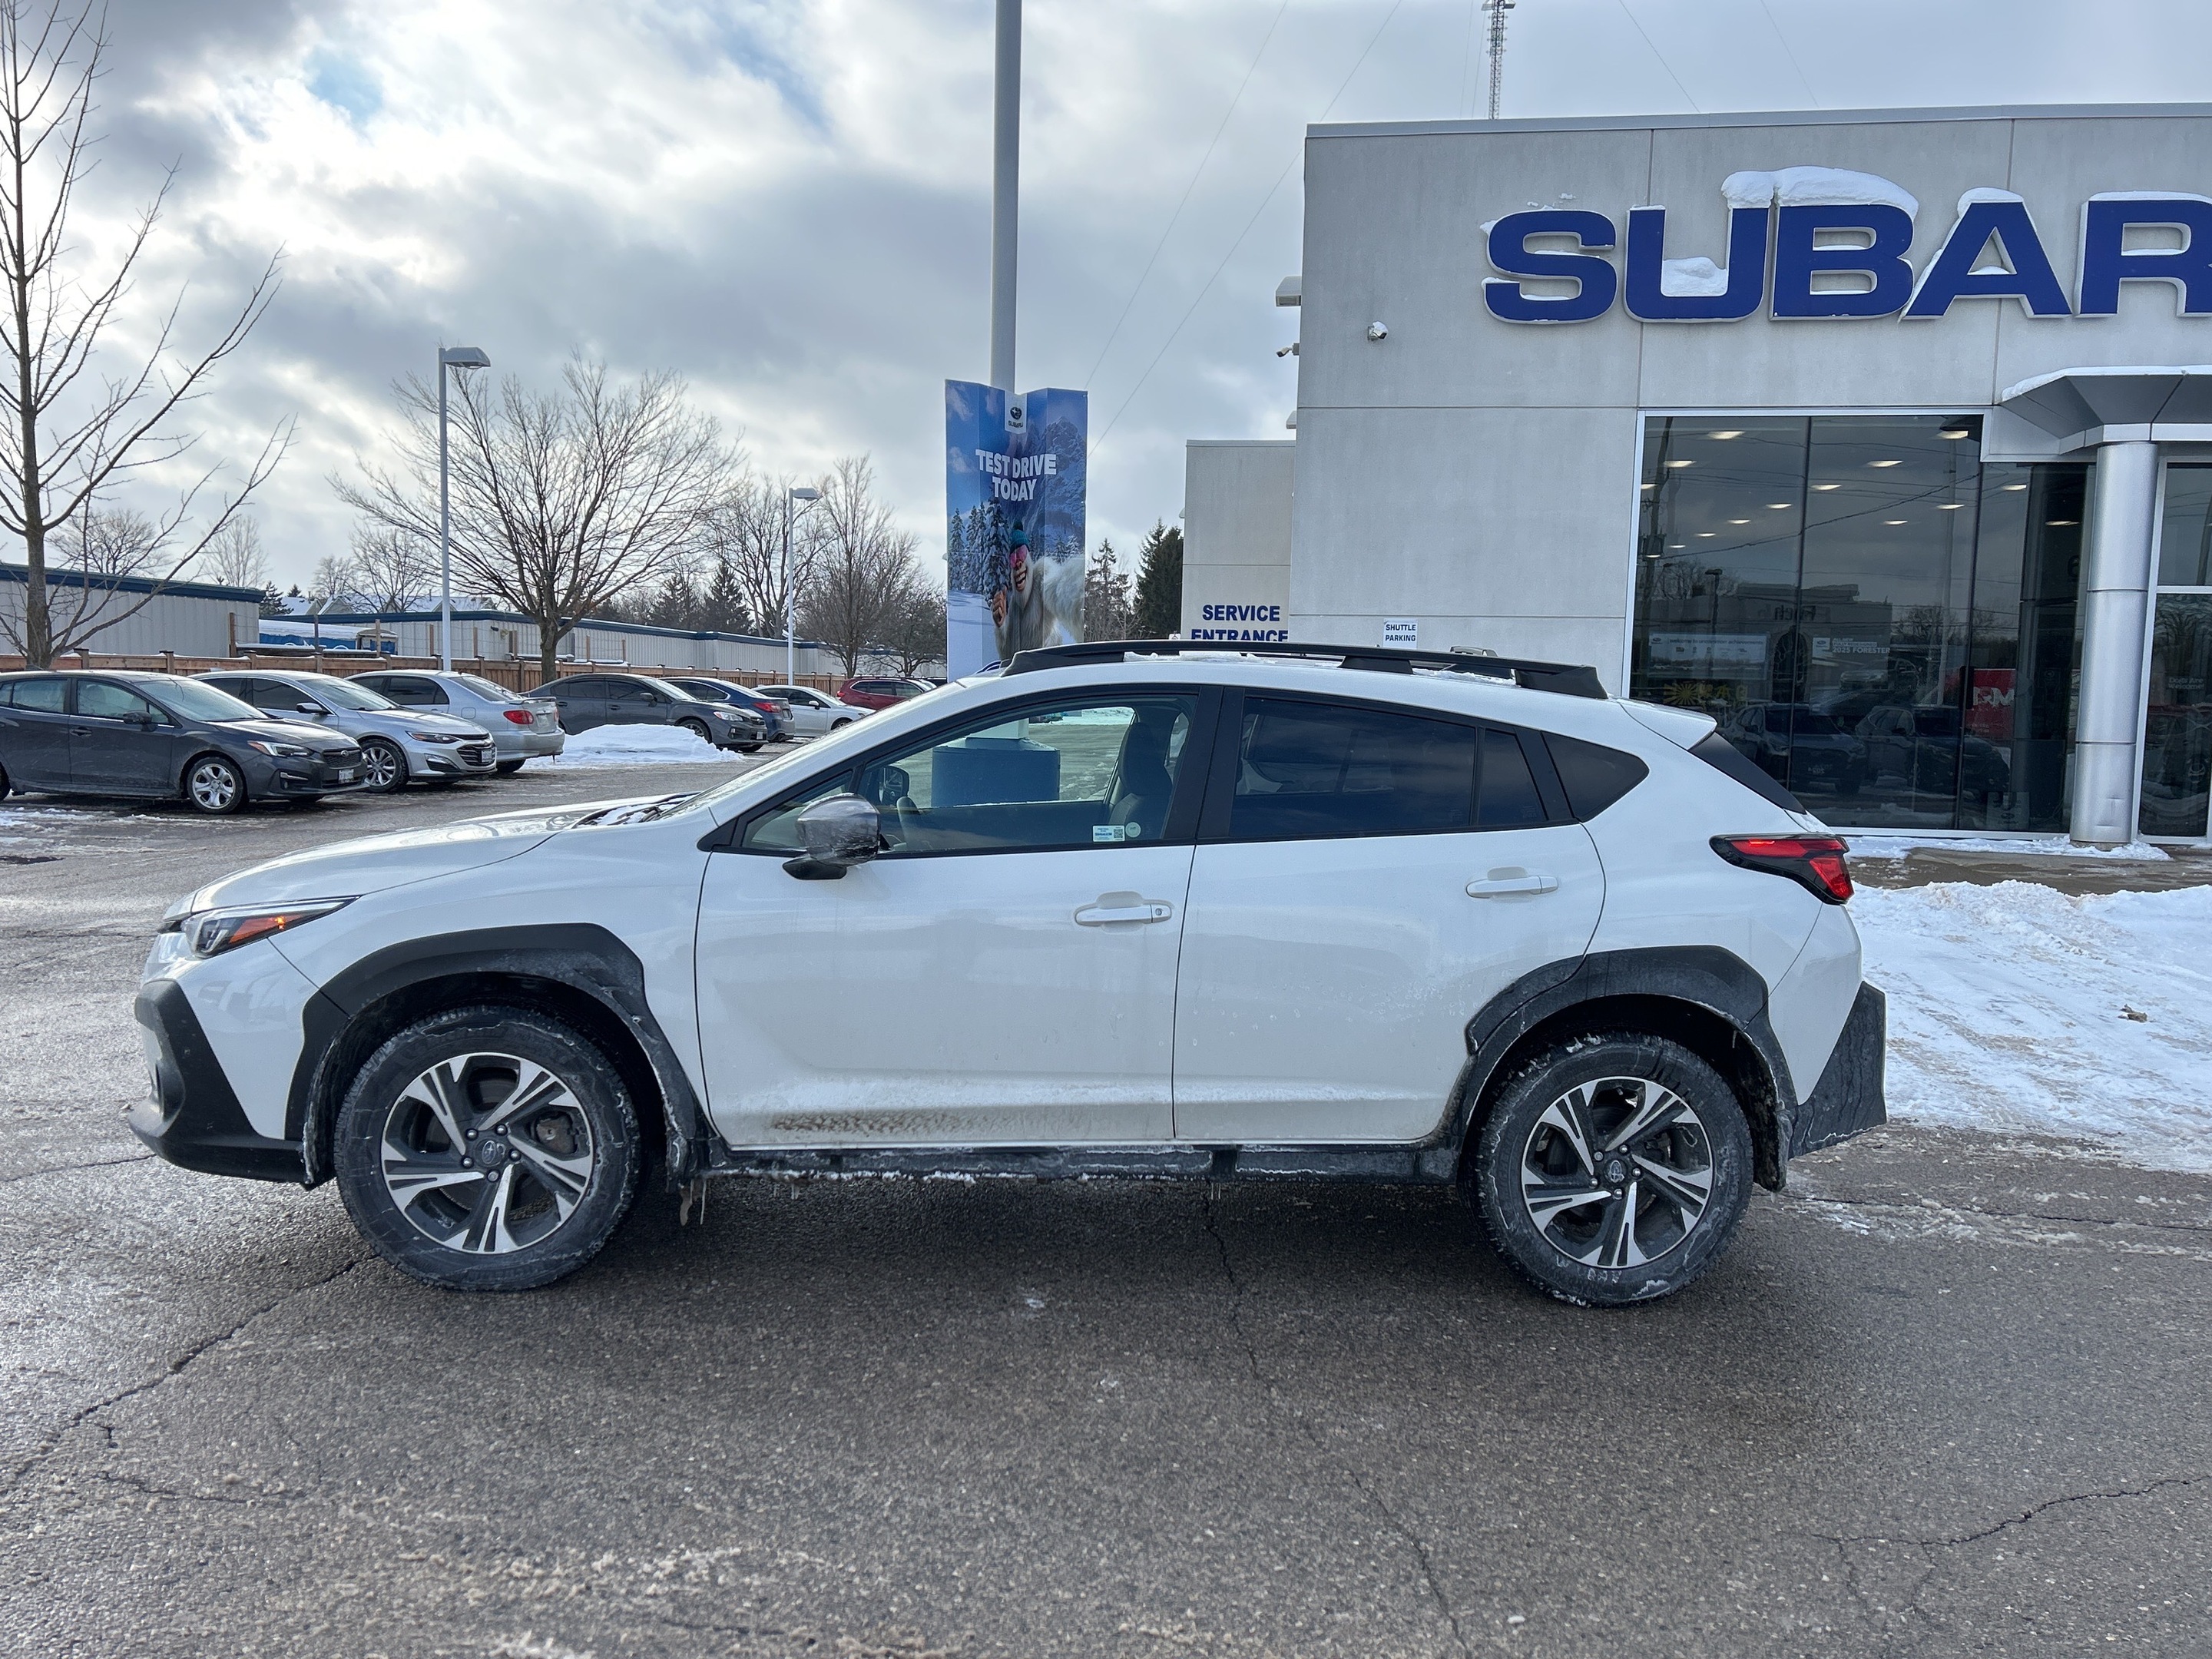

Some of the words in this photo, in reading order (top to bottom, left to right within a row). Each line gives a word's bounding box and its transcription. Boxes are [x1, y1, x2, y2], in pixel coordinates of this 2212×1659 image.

[975, 449, 1011, 475] TEST
[1012, 452, 1057, 478] DRIVE
[992, 475, 1038, 502] TODAY
[1202, 604, 1281, 622] SERVICE
[1190, 628, 1289, 642] ENTRANCE
[1385, 623, 1417, 632] SHUTTLE
[1385, 634, 1416, 643] PARKING
